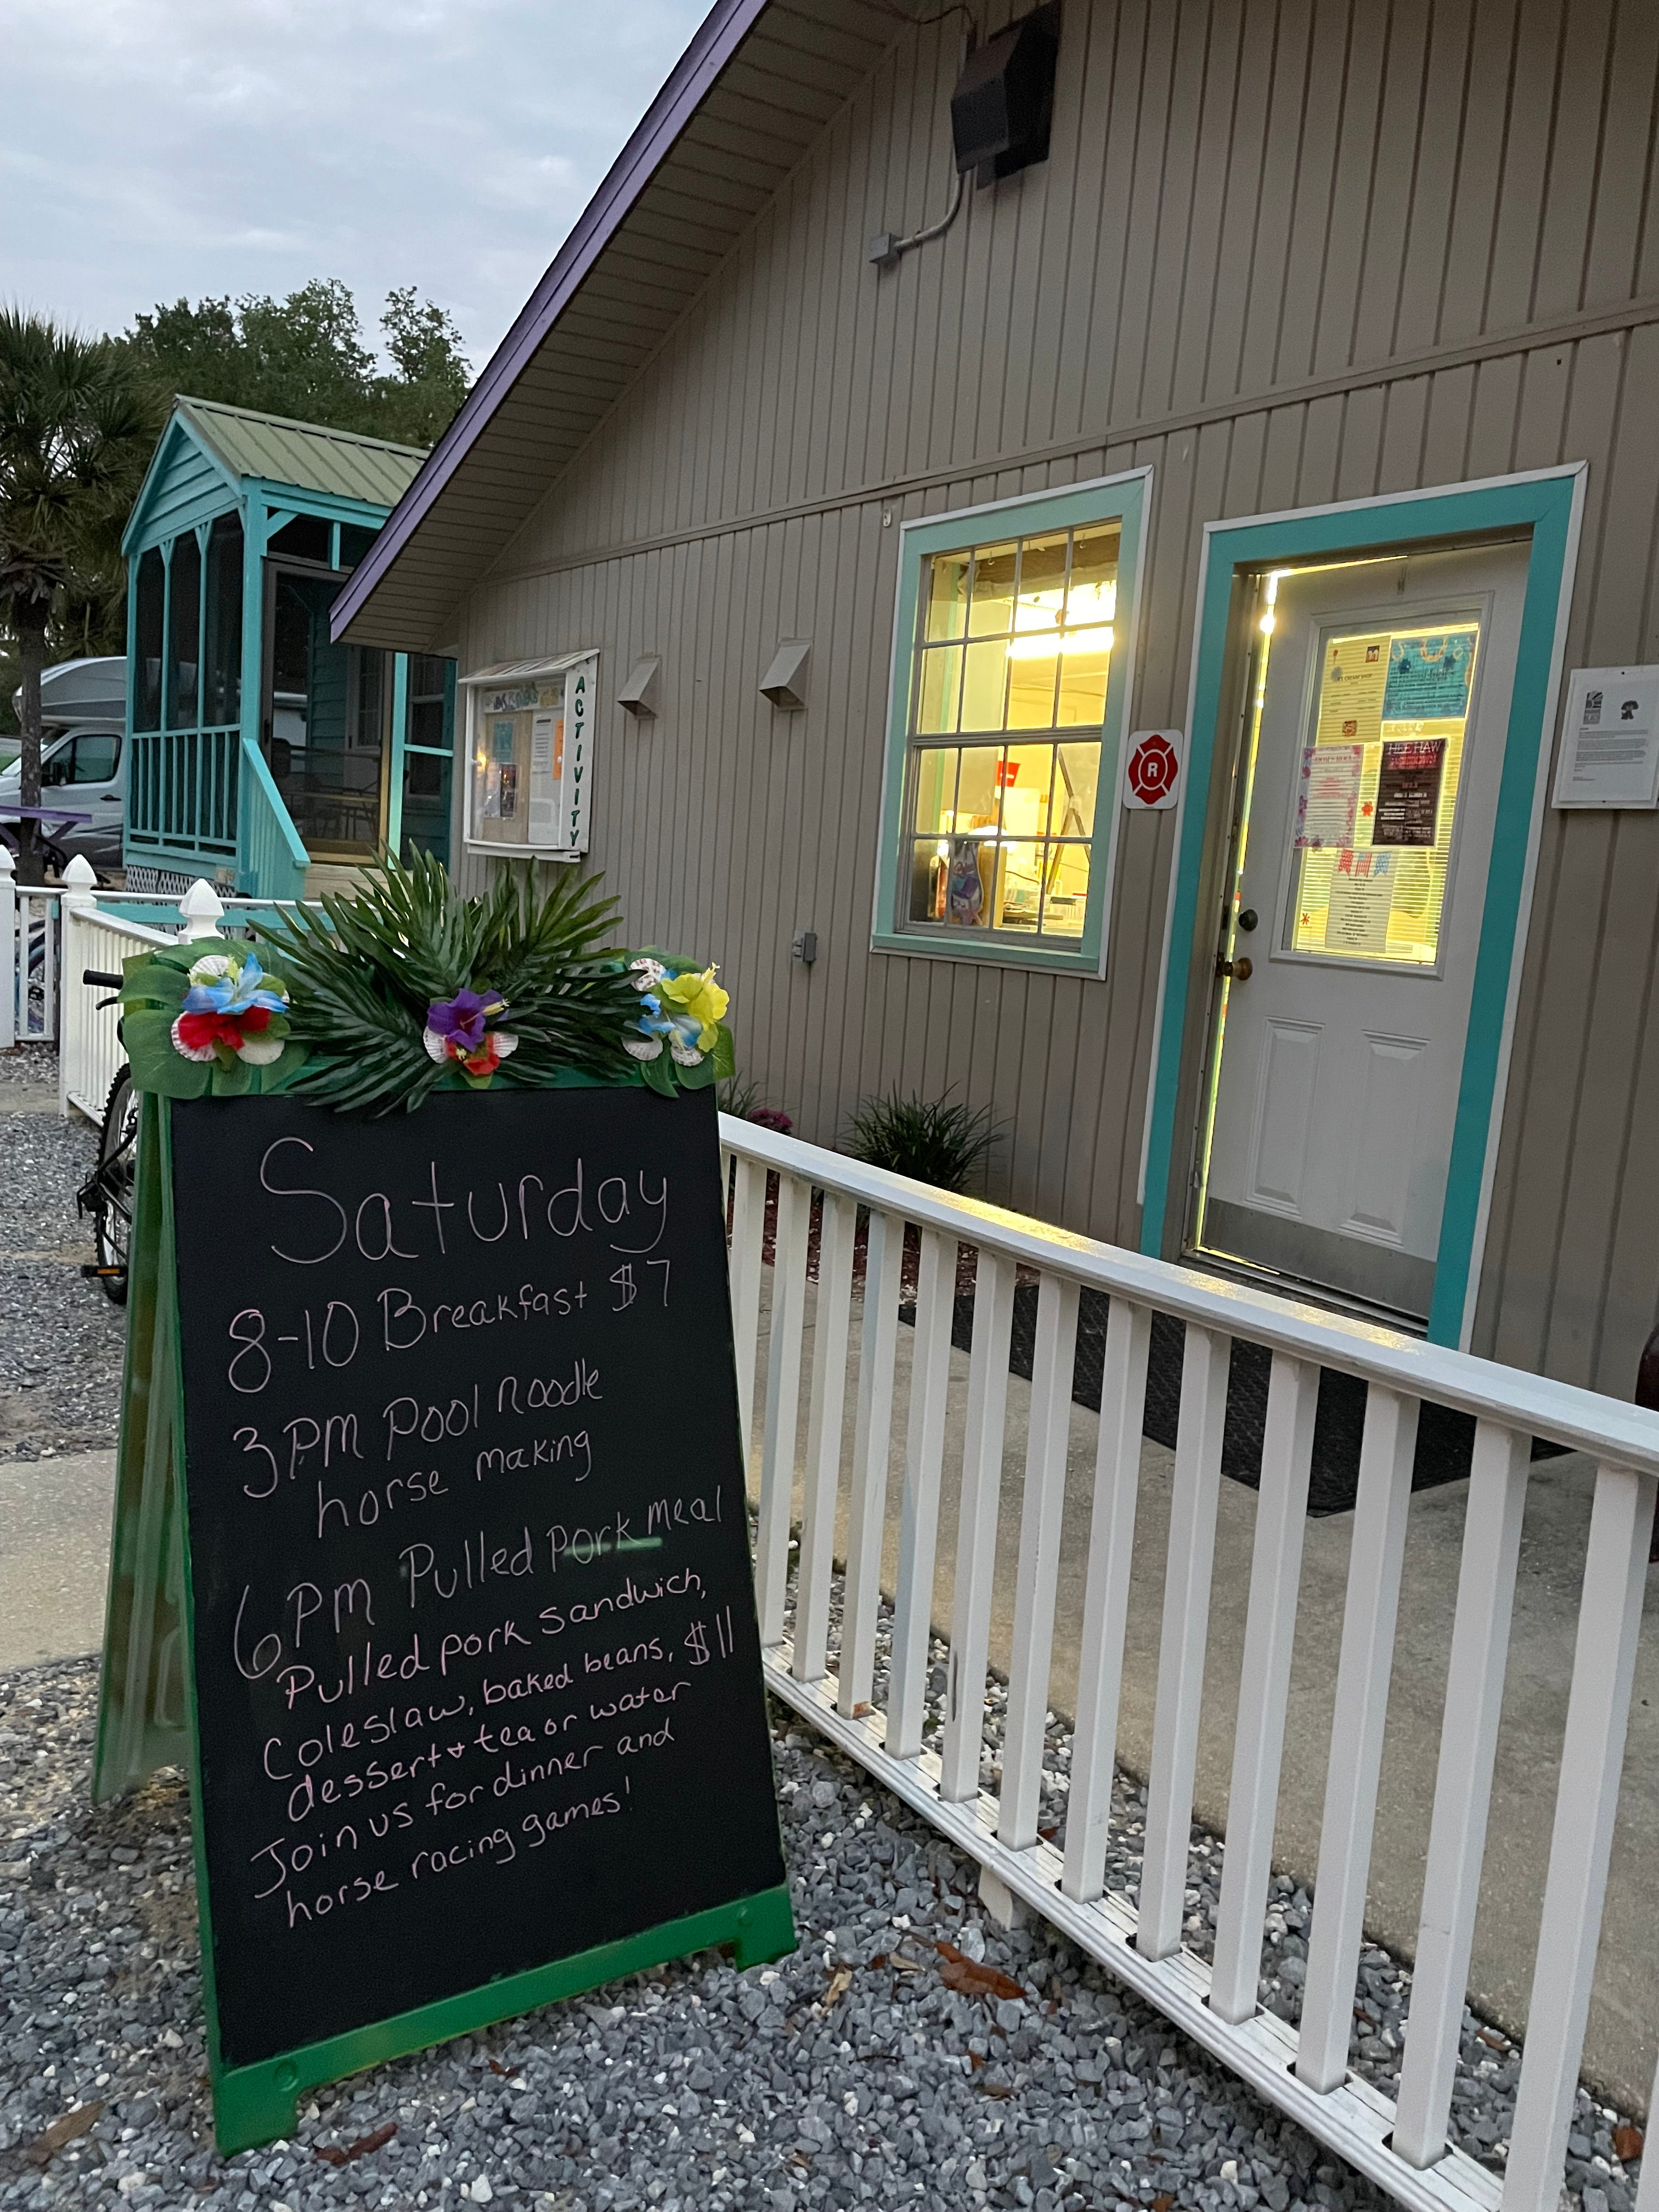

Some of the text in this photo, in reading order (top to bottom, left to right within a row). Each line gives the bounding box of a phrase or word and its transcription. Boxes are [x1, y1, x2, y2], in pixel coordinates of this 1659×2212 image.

[570, 676, 585, 847] ACTIVITY
[1147, 762, 1158, 777] R
[1413, 741, 1441, 753] HAW
[260, 1137, 667, 1263] Saturday
[228, 1301, 359, 1393] 8-10
[376, 1280, 588, 1352] Breakfast
[318, 1430, 591, 1539] horse making
[398, 1526, 534, 1609] Pulled
[275, 1633, 431, 1710] Pulled
[441, 1620, 532, 1677] pork
[482, 1662, 574, 1705] baked
[287, 1742, 442, 1822] dessert
[473, 1723, 536, 1753] tea
[544, 1714, 578, 1736] or
[589, 1681, 691, 1720] water
[250, 1717, 675, 1899] Join us for dinner and
[286, 1775, 633, 1928] horse racing games!
